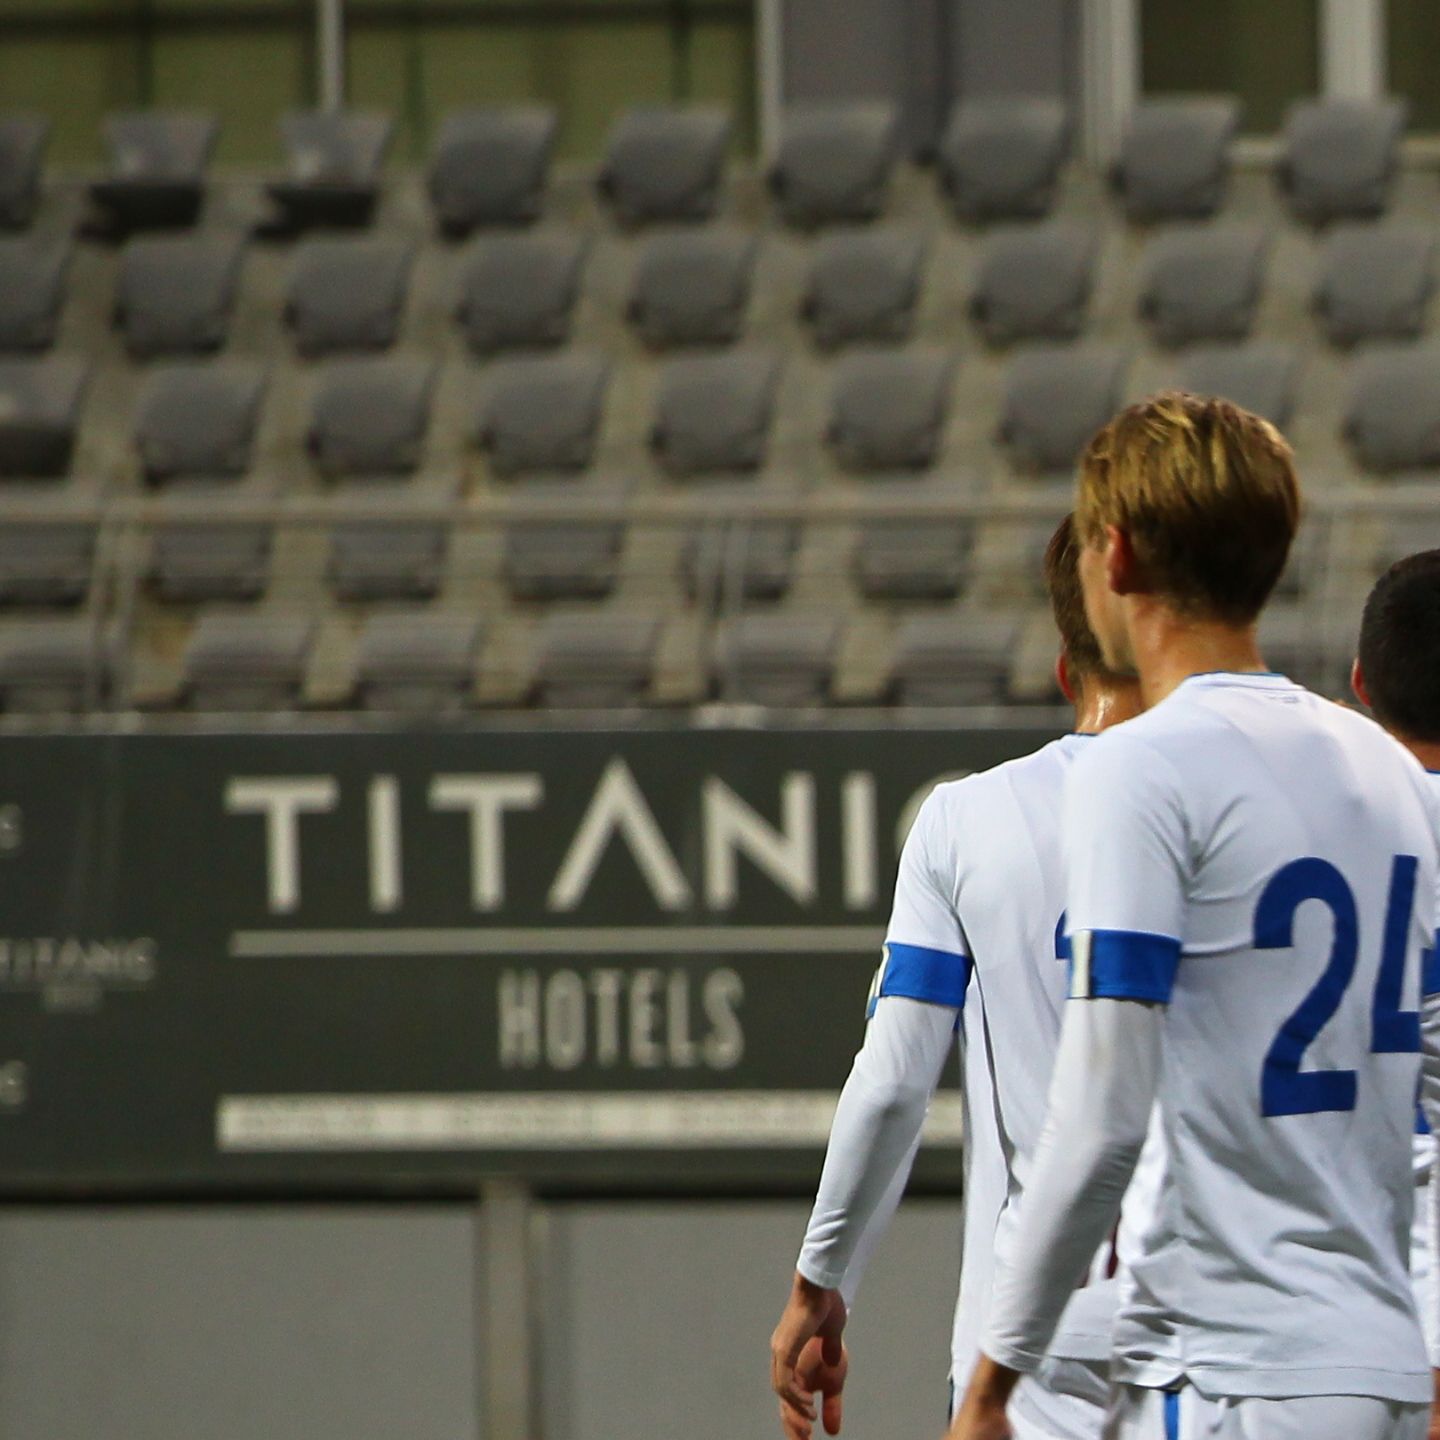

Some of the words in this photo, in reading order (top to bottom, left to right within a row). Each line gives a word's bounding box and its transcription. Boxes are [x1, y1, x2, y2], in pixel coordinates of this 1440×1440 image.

[224, 755, 962, 913] TITANI
[500, 967, 746, 1072] HOTELS
[1253, 854, 1432, 1117] 24
